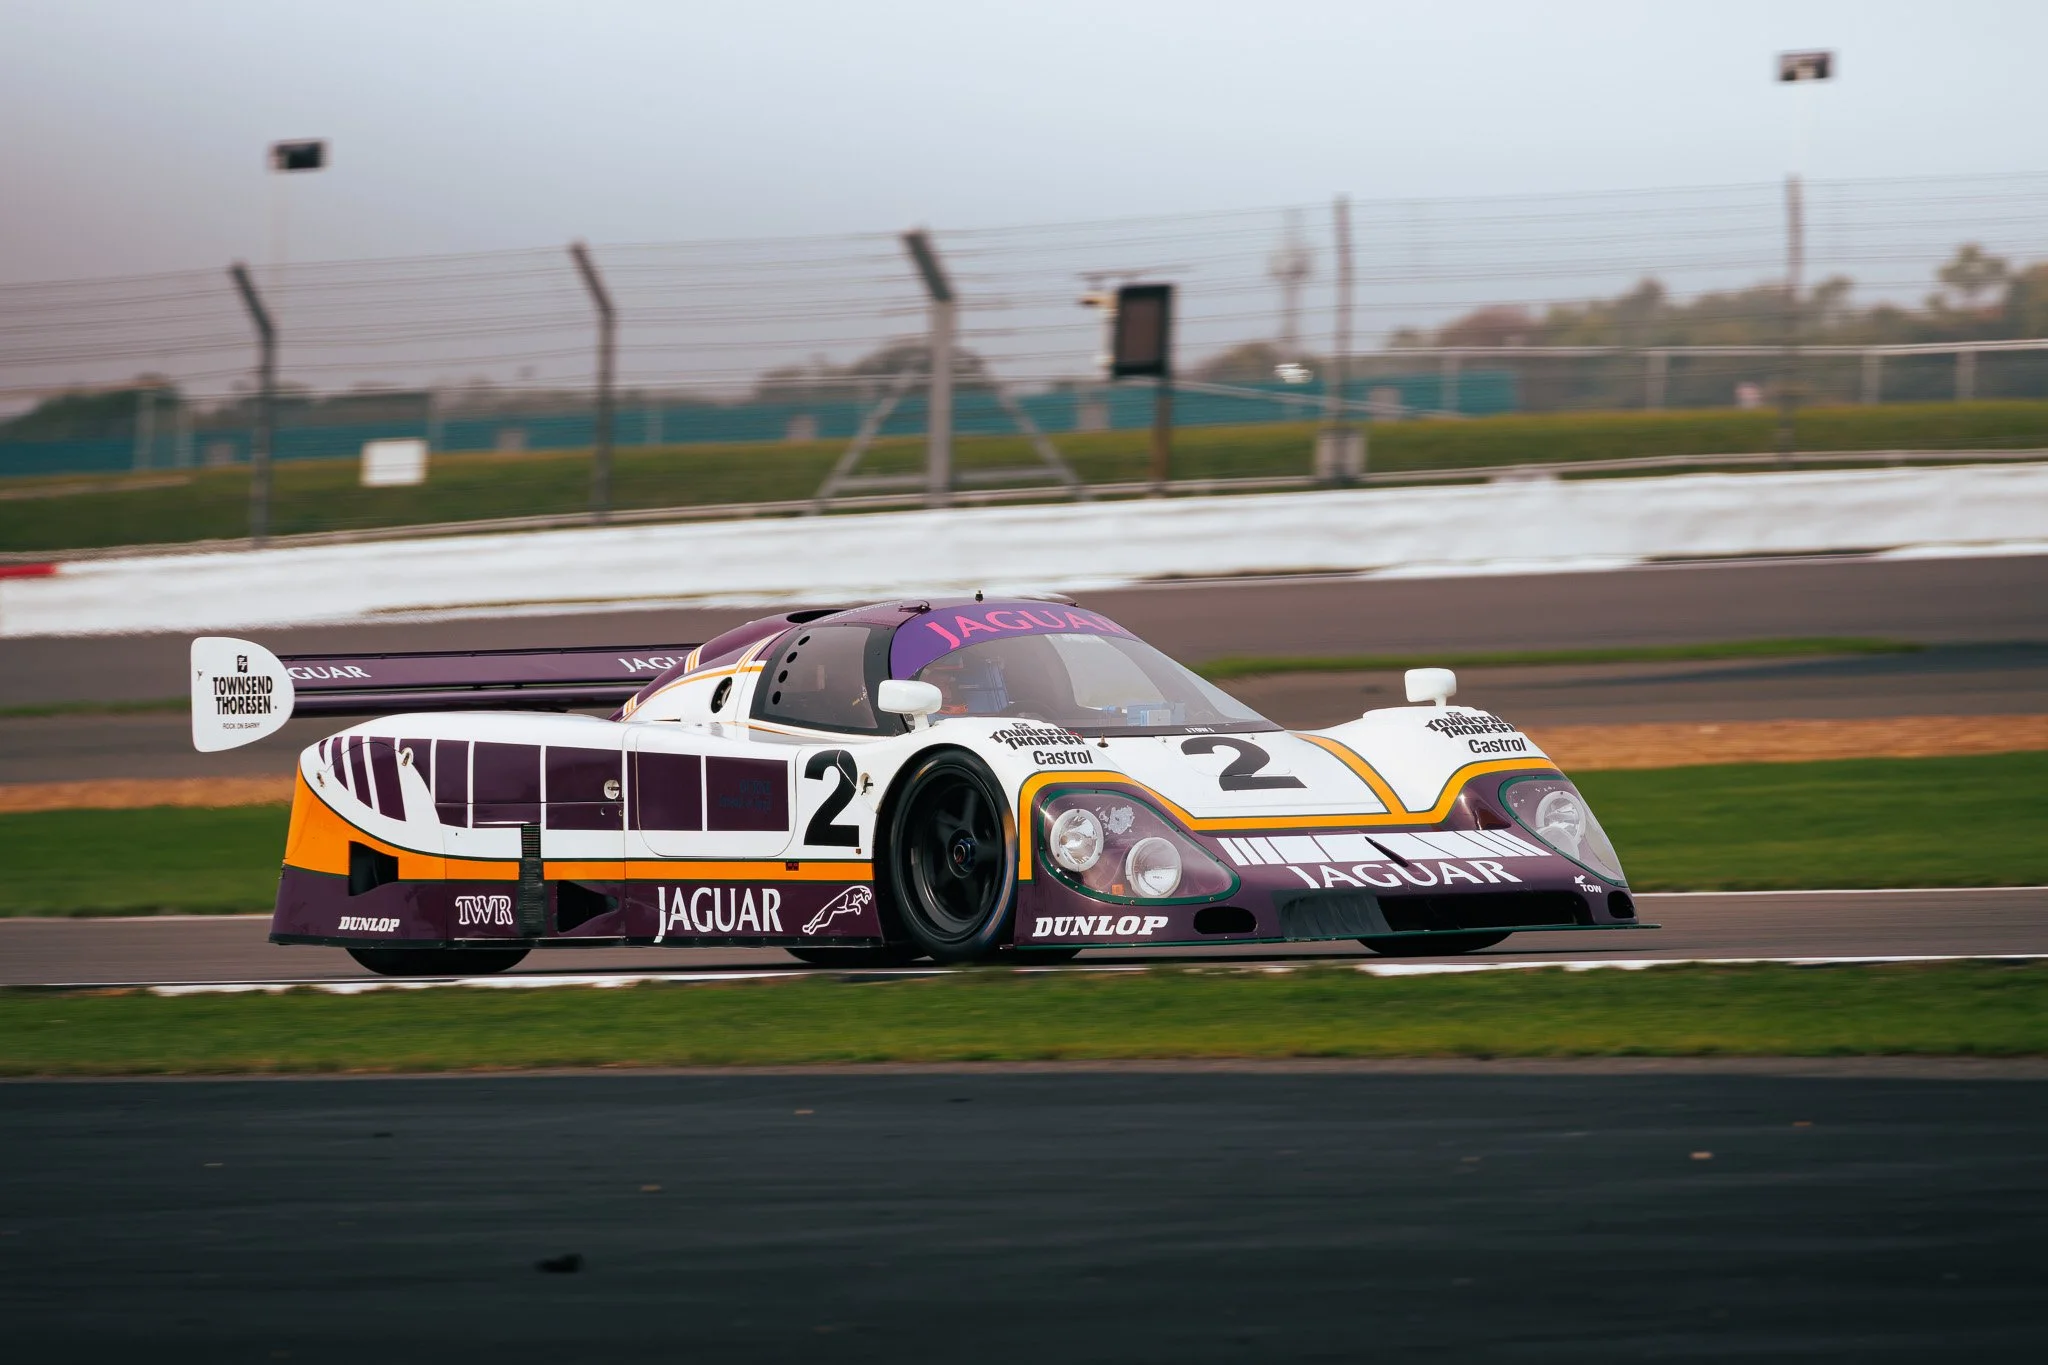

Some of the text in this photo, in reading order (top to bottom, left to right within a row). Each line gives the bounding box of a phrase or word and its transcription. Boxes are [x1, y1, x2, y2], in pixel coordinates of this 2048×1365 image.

[925, 610, 1122, 650] JAGUAR
[286, 665, 372, 680] GUAR
[212, 675, 273, 696] TOWNSEND
[215, 695, 271, 715] THORESEN
[1425, 715, 1503, 732] TOWNSEN
[989, 727, 1069, 744] TOWNSEN
[1468, 737, 1527, 754] Castrol
[1032, 750, 1094, 765] Castrol
[1180, 736, 1307, 791] 2
[803, 749, 858, 847] 2
[1286, 860, 1523, 889] JAGUAR
[1580, 884, 1603, 894] TOW
[455, 895, 514, 925] TWR
[653, 886, 783, 943] JAGUAR
[338, 916, 400, 932] DUNLOP
[1032, 915, 1169, 937] DUNLOP
